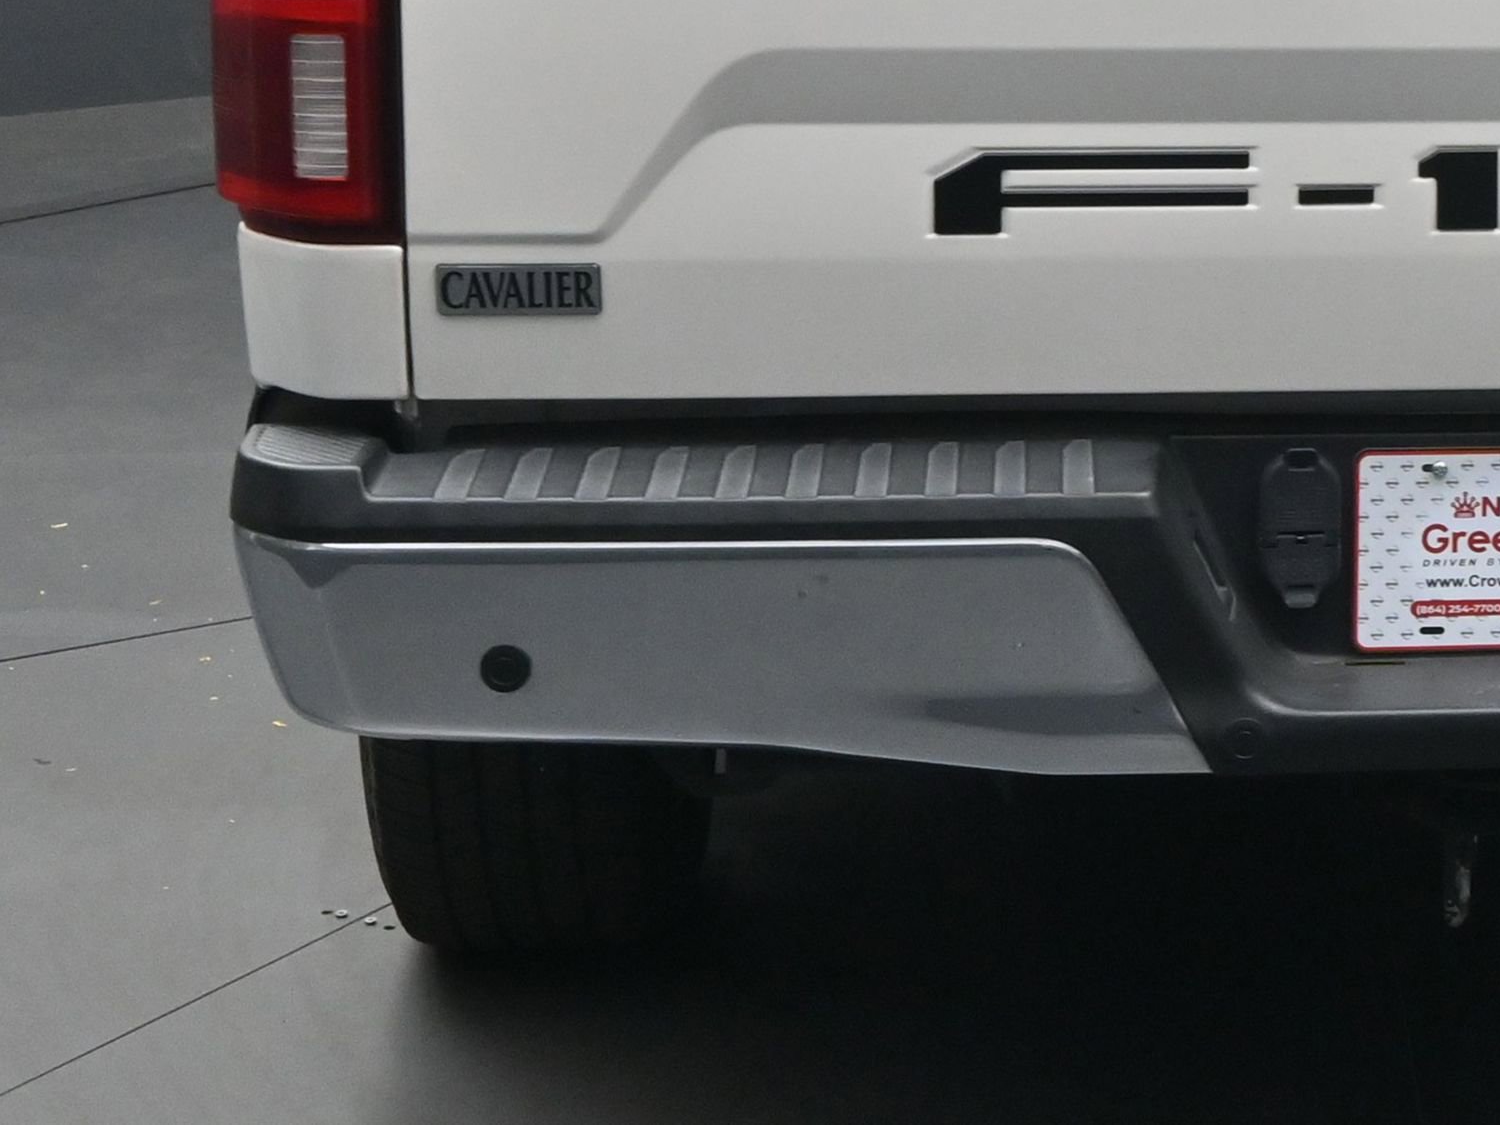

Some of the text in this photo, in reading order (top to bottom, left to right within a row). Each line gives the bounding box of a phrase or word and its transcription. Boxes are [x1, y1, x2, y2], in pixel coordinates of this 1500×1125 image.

[440, 270, 597, 309] CAVALIER
[1422, 558, 1478, 568] DRIVEN
[1416, 604, 1446, 615] (864)
